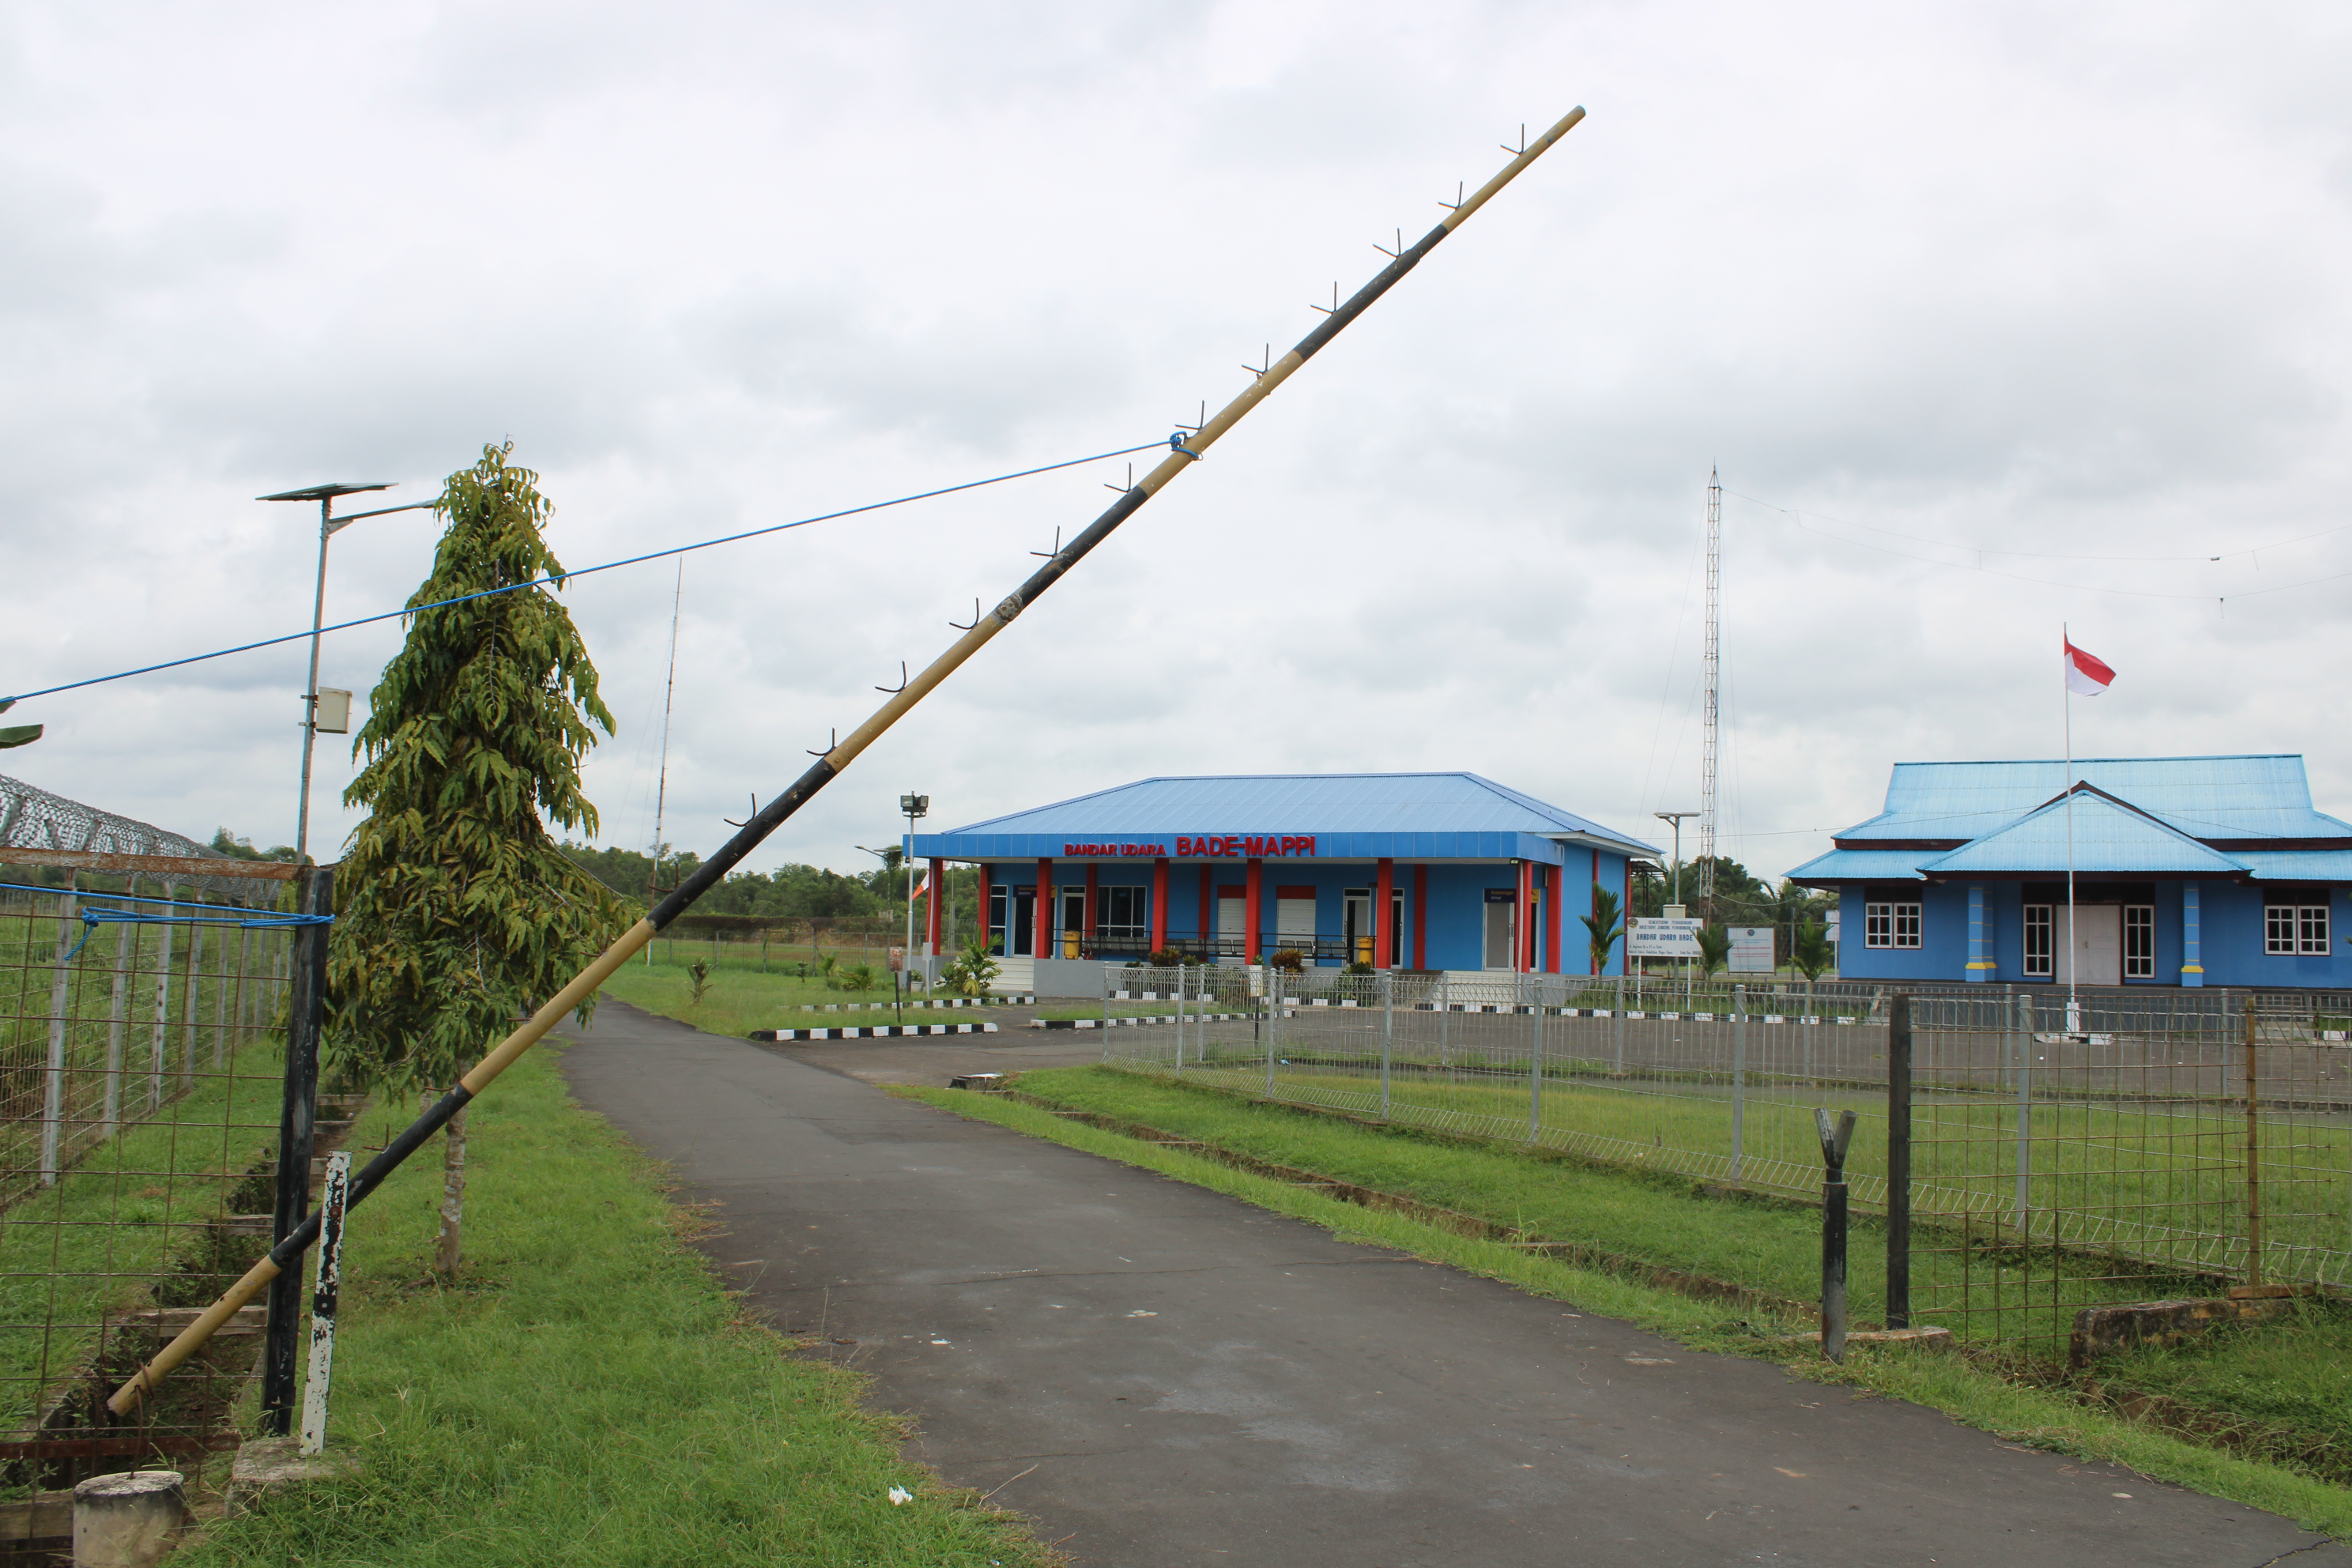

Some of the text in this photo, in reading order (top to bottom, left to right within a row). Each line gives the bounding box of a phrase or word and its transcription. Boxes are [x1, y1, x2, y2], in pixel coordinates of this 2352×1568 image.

[1065, 835, 1316, 856] BANDAR UDARA BADE-MAPPI
